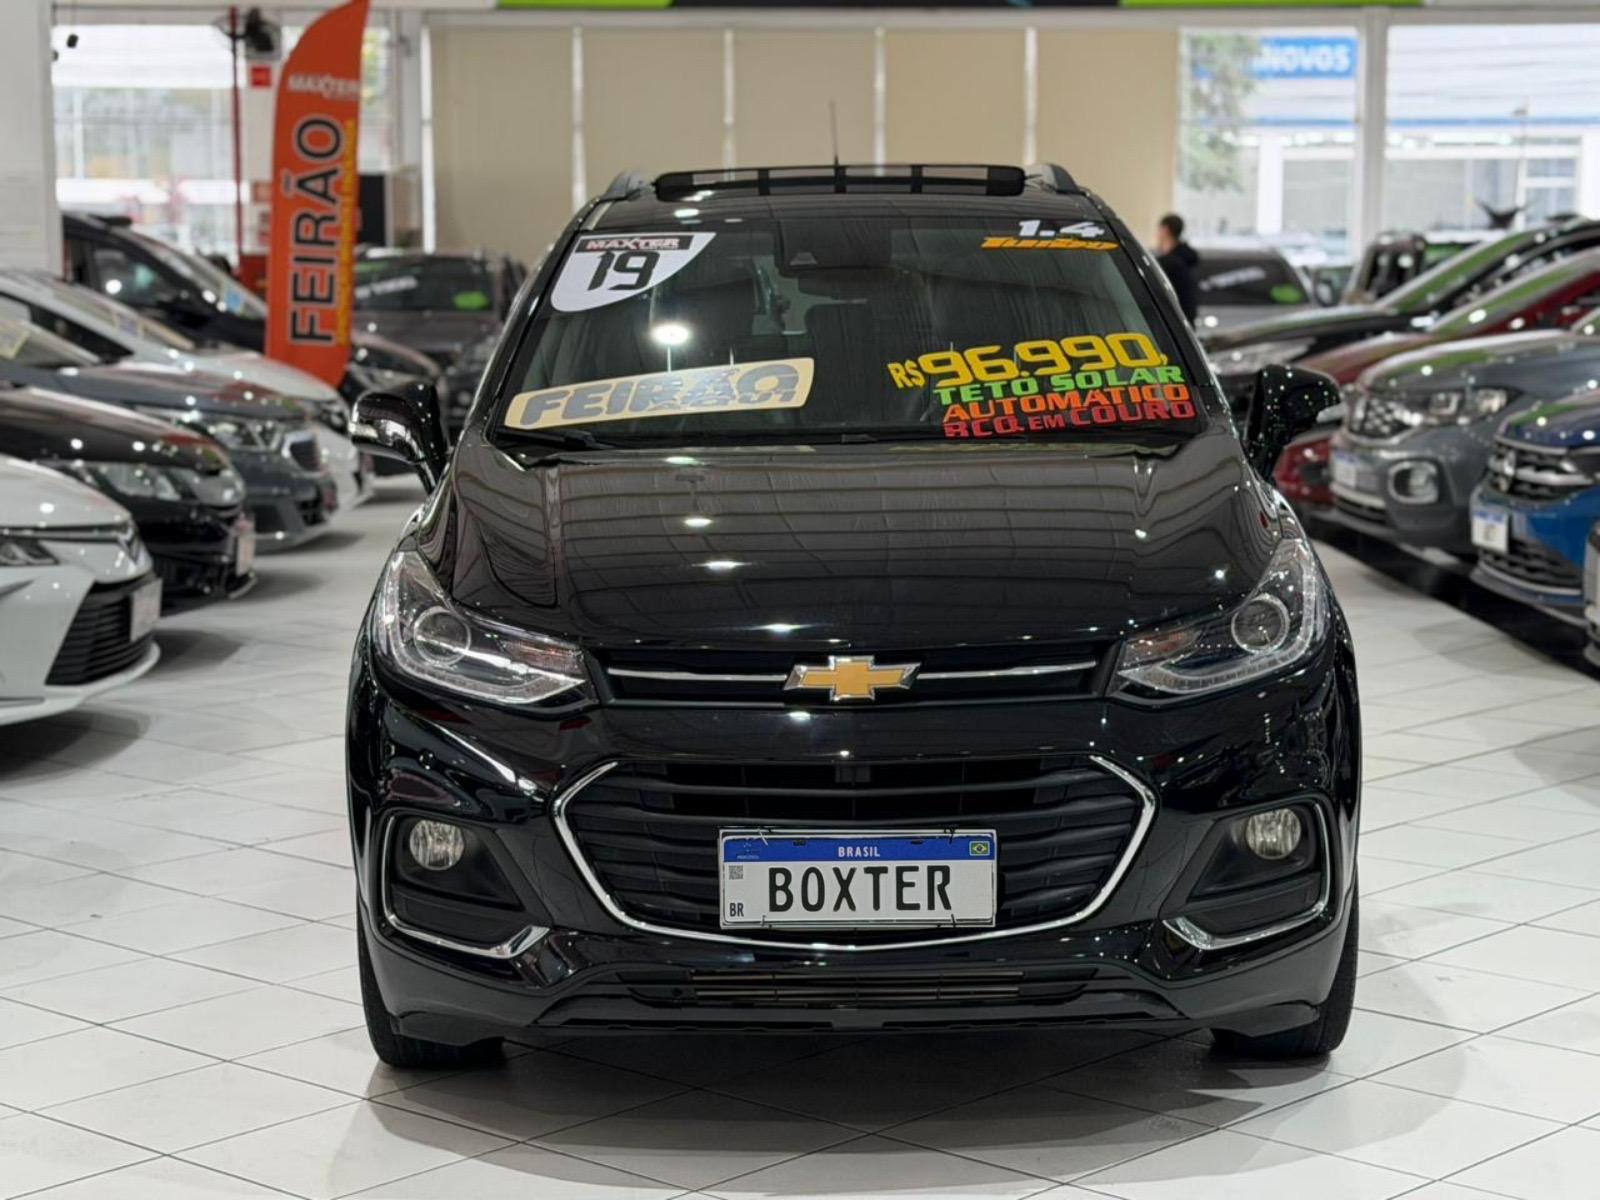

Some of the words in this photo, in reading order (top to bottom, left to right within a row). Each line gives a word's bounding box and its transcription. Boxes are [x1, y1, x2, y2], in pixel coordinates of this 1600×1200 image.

[281, 117, 344, 346] FEIRÃO
[1018, 219, 1105, 238] 1.4
[588, 251, 661, 292] 19
[933, 370, 1039, 405] TETO
[1050, 366, 1186, 393] SOLAR
[1029, 414, 1066, 432] EM
[1071, 402, 1197, 427] COURO
[837, 845, 881, 858] BRASIL
[768, 865, 953, 913] BOXTER
[729, 902, 745, 917] BR
